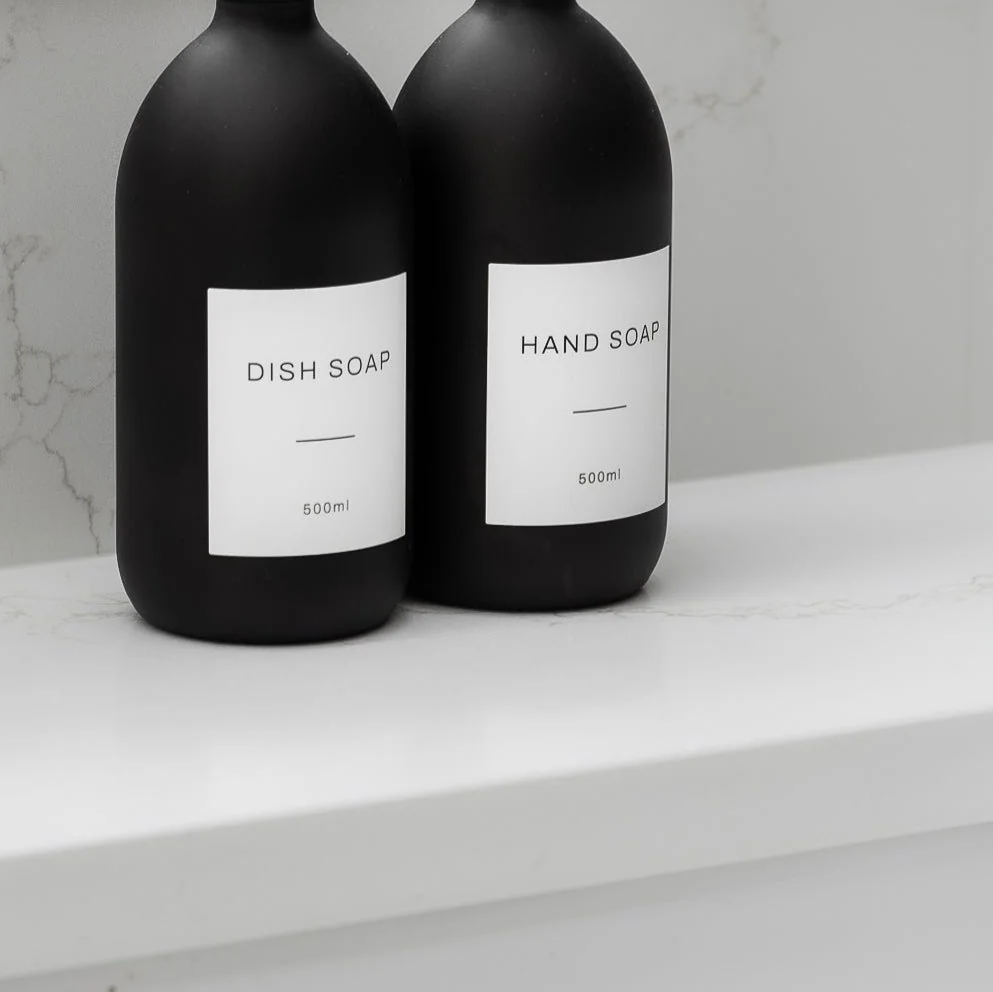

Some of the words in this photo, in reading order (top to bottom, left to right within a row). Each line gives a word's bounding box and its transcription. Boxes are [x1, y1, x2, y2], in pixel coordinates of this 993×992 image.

[521, 333, 599, 355] HAND
[609, 320, 661, 350] SOAP
[247, 360, 317, 382] DISH
[329, 349, 392, 379] SOAP
[578, 467, 622, 486] 500ml
[302, 499, 350, 516] 500ml
